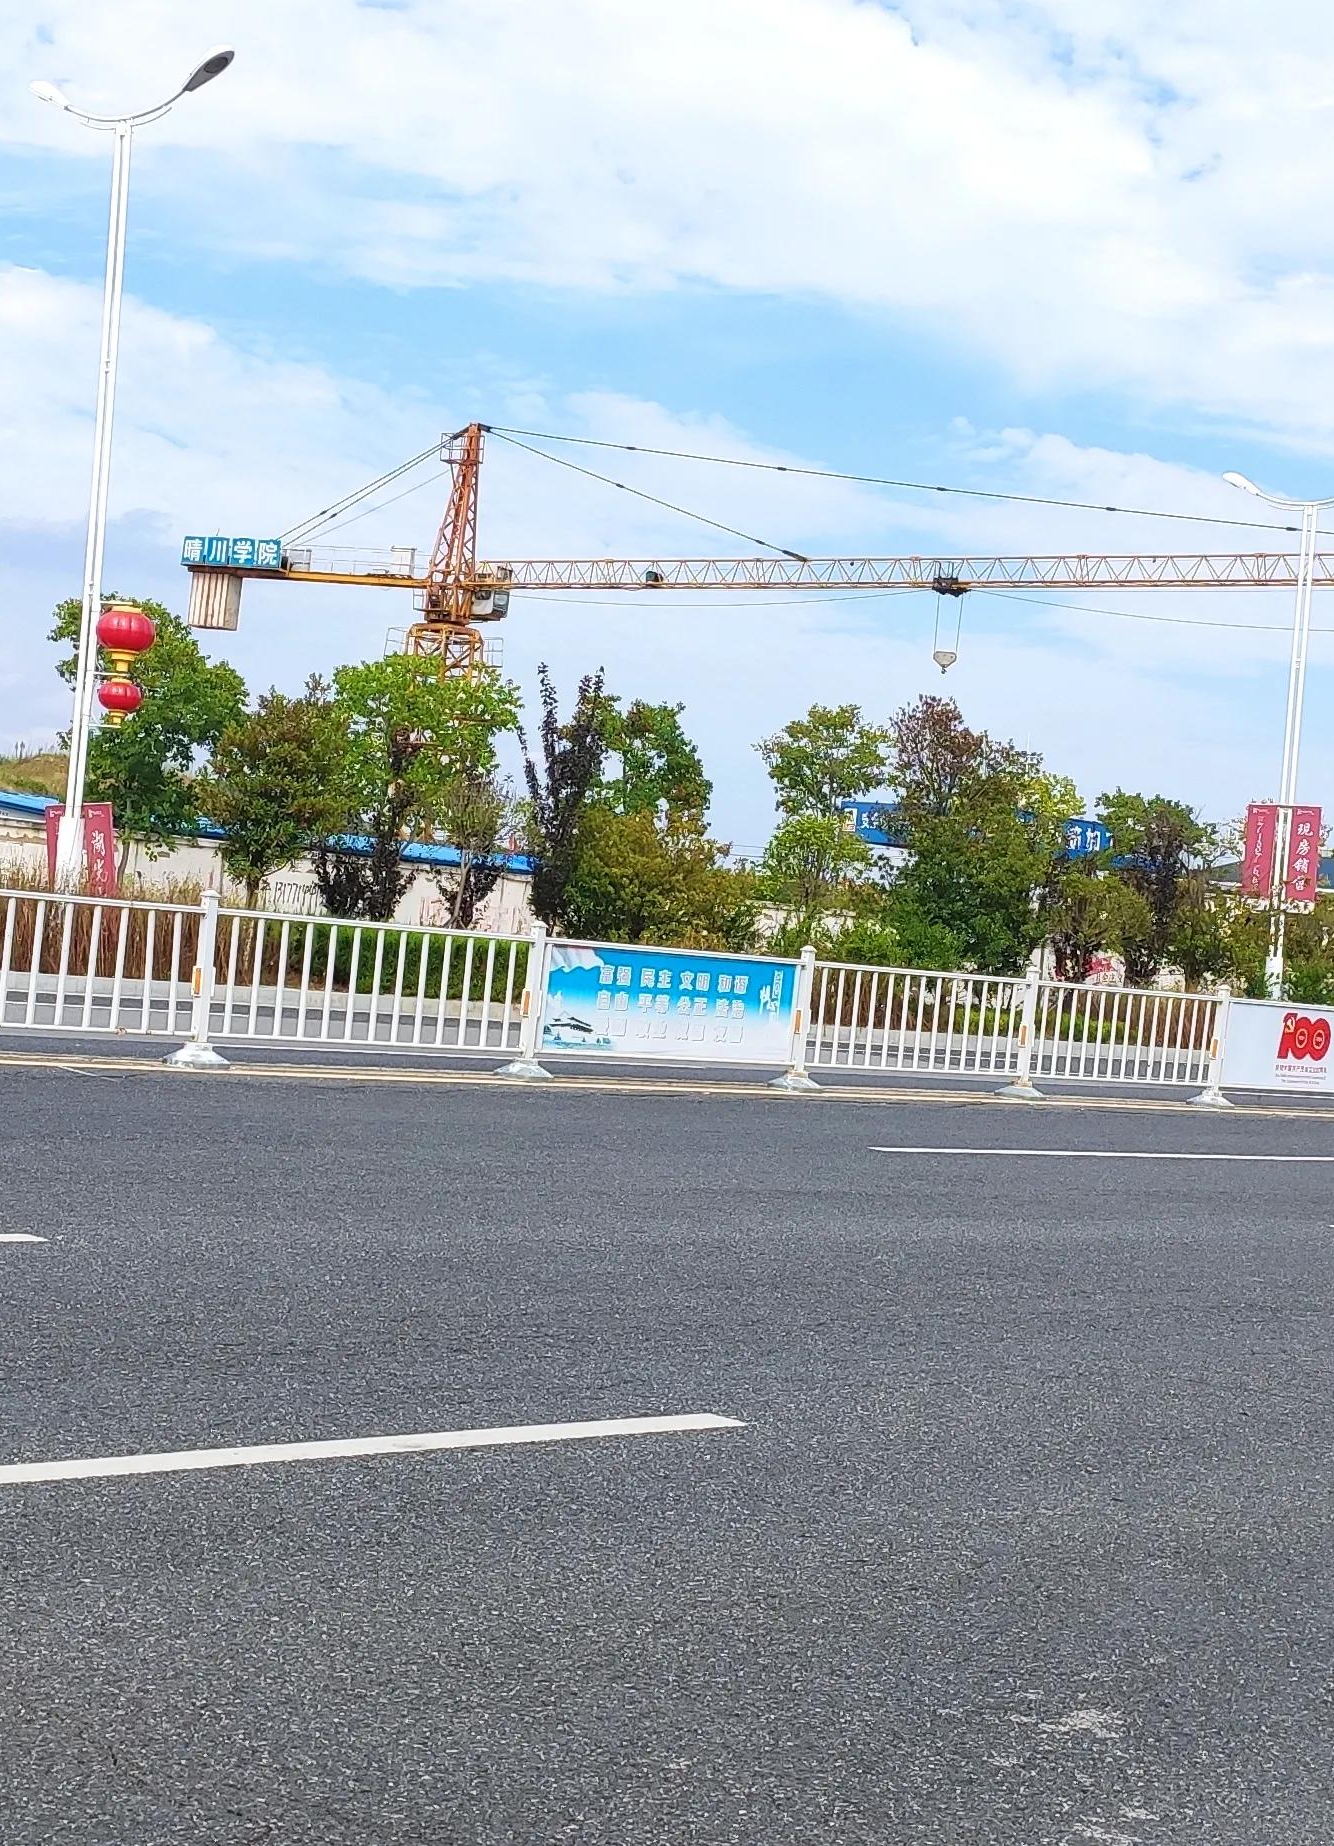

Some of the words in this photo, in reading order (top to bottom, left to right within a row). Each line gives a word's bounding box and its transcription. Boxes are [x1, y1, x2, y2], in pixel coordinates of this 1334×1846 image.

[183, 538, 278, 565] 晴川学院
[599, 965, 632, 987] 富强
[640, 967, 672, 990] 民主
[679, 970, 711, 993] 文明
[719, 974, 750, 995] 和谐
[596, 990, 630, 1012] 自由
[676, 995, 708, 1017] 公正
